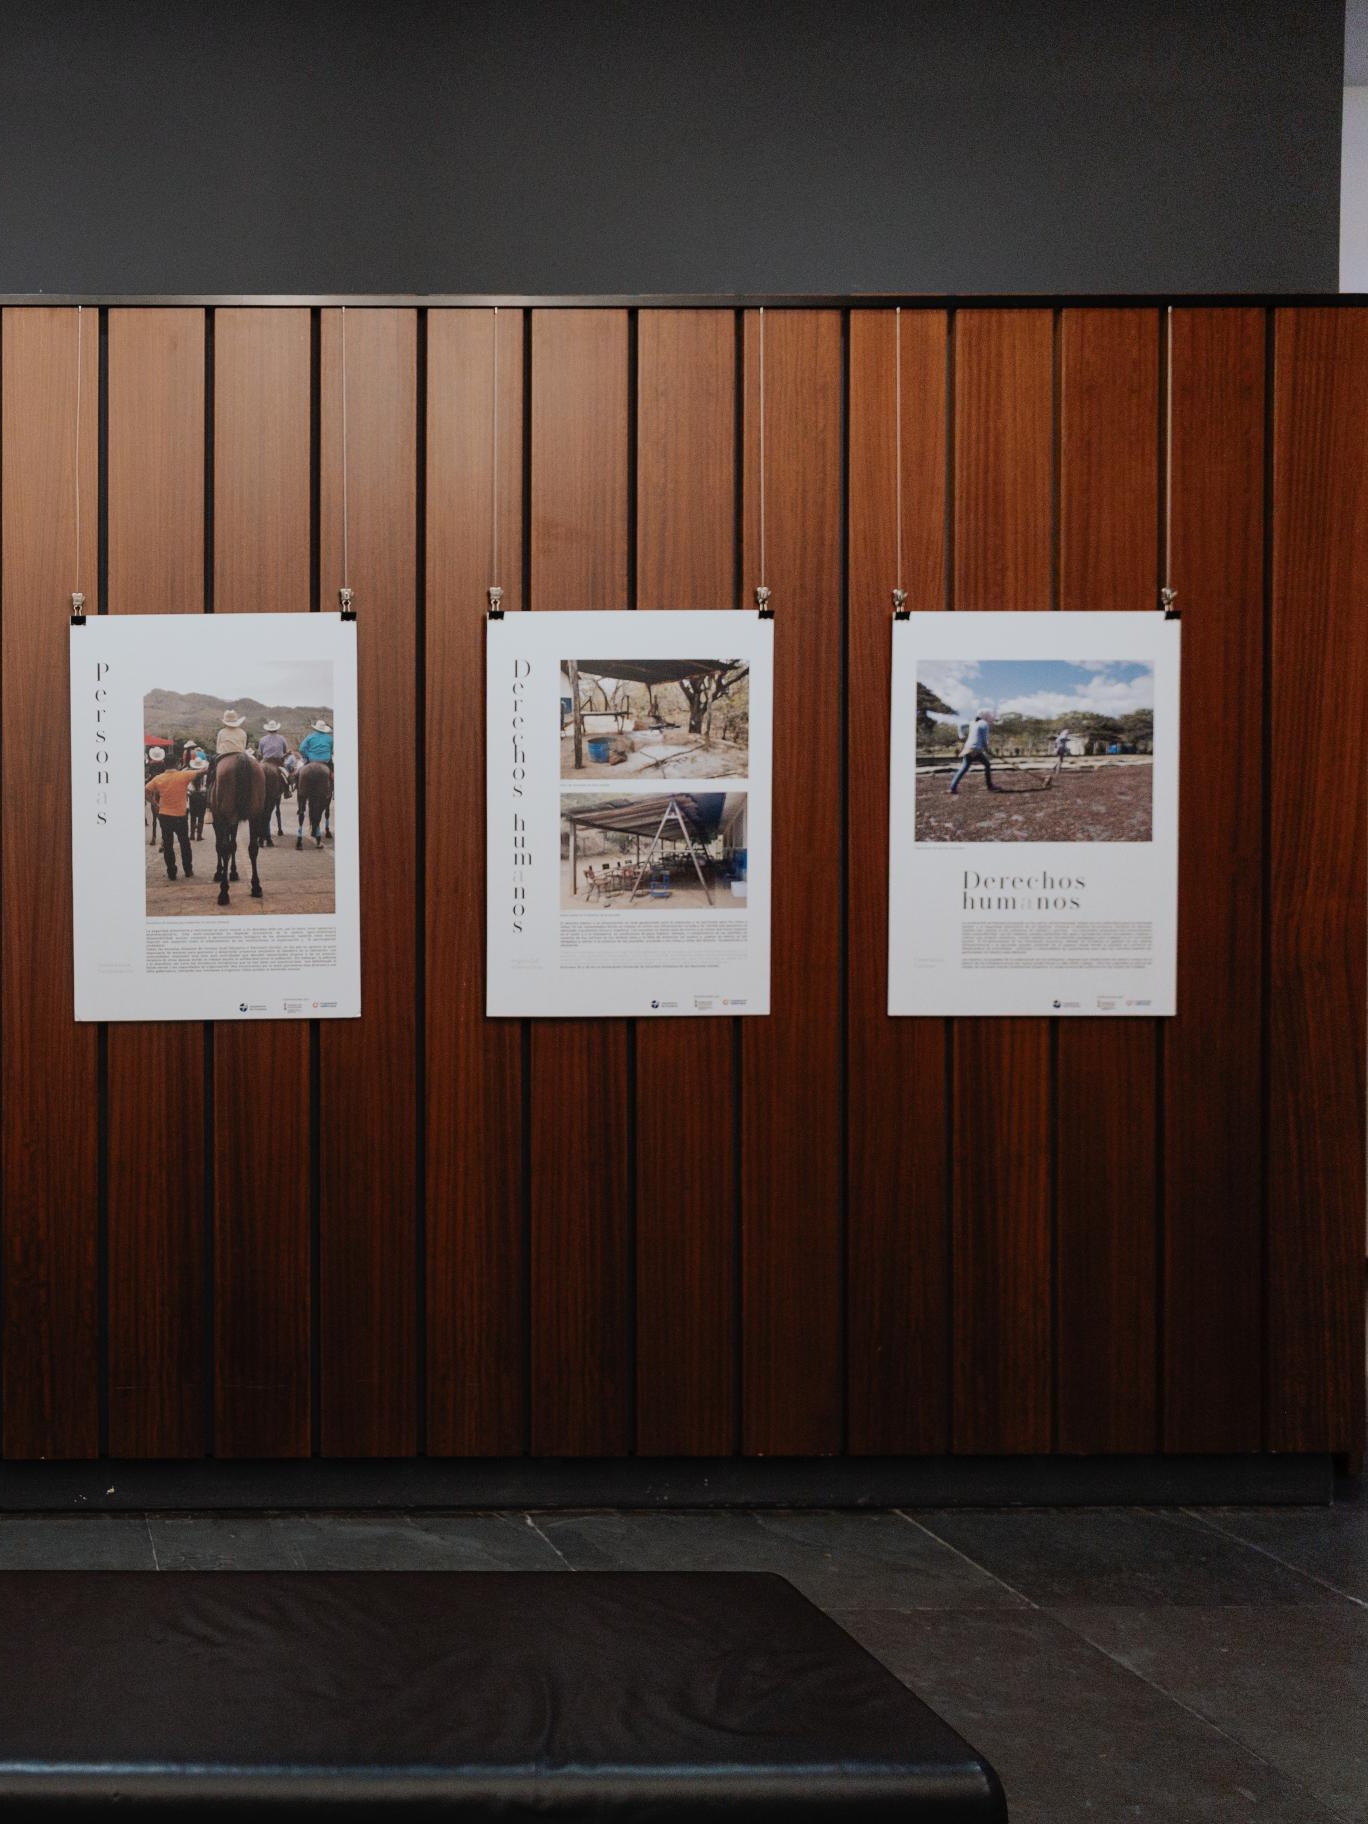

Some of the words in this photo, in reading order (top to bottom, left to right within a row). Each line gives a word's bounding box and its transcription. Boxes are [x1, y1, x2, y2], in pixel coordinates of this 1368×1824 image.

[94, 662, 110, 825] Personas
[512, 659, 531, 798] Derechos
[512, 812, 533, 934] humanos
[962, 891, 1081, 910] humanos
[963, 871, 1086, 890] Derechos
